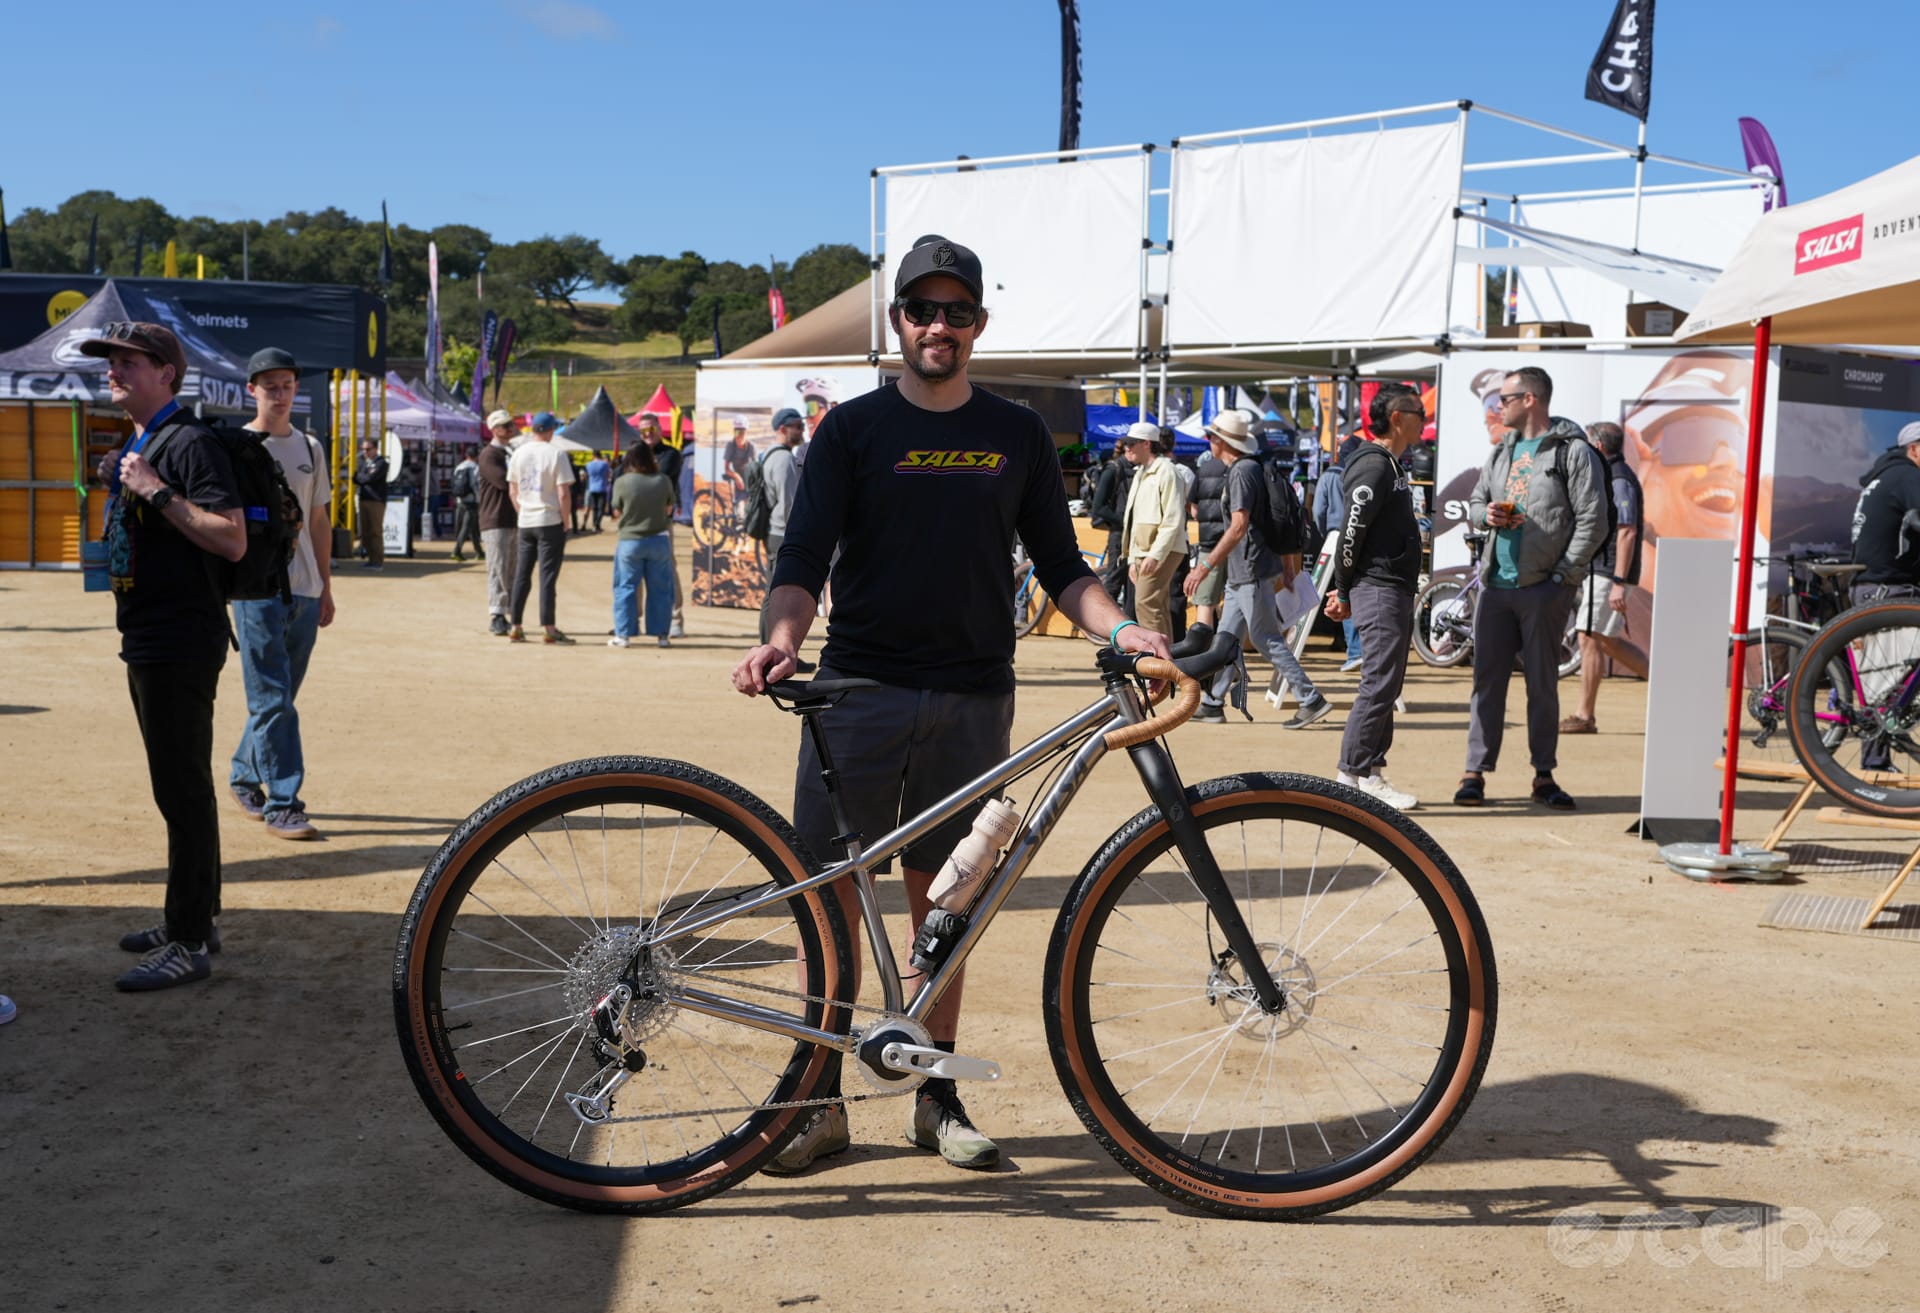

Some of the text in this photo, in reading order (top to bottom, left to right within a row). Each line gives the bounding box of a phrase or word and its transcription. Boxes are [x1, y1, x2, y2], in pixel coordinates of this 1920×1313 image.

[1600, 0, 1640, 92] CHA
[1798, 227, 1860, 264] SALSA
[202, 377, 243, 410] SILCA
[896, 450, 1006, 475] SALSA
[1342, 485, 1374, 567] Cadence
[1023, 756, 1090, 848] SALSA
